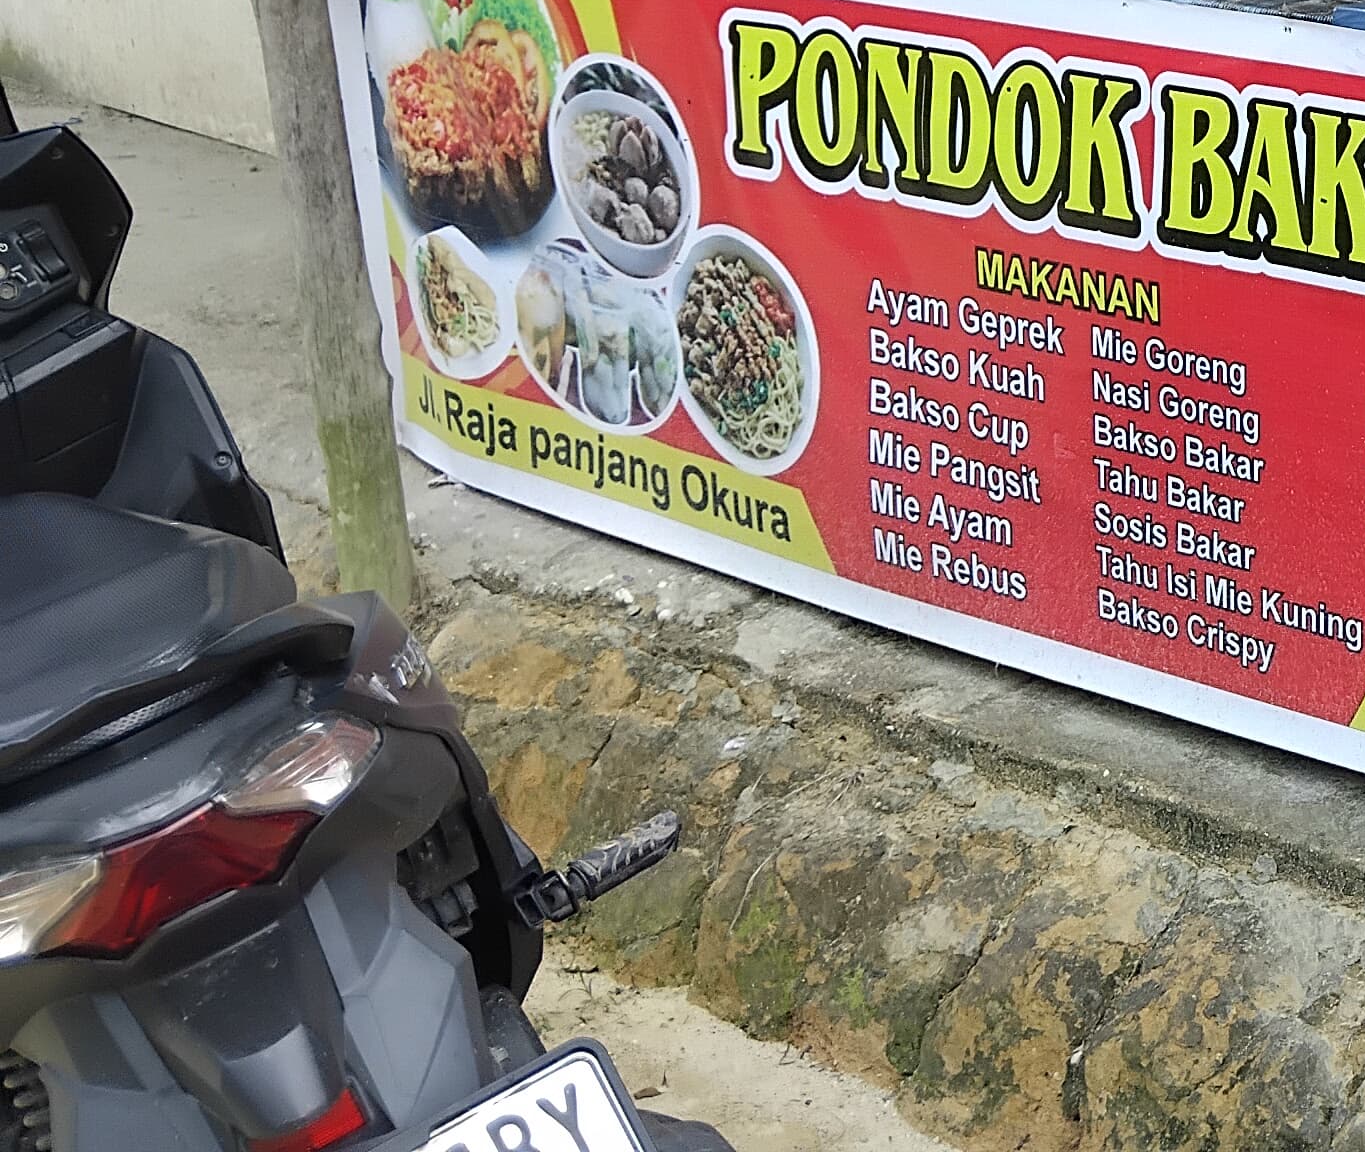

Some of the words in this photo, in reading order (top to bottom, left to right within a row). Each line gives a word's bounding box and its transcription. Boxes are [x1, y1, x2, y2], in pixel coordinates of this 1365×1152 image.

[731, 20, 1141, 238] PONDOK
[867, 278, 948, 329] Ayam
[958, 298, 1064, 355] Geprek
[976, 248, 1161, 324] MAKANAN
[869, 328, 960, 382] Bakso
[968, 350, 1046, 401] Kuah
[1091, 326, 1137, 364] Mie
[1144, 338, 1247, 396] Goreng
[869, 378, 959, 431] Bakso
[968, 404, 1029, 456] Cup
[1093, 371, 1150, 412] Nasi
[1158, 386, 1260, 444] Goreng
[444, 389, 518, 458] Raja
[529, 425, 670, 511] panjang
[681, 464, 791, 543] Okura
[868, 428, 921, 472] Mie
[930, 442, 1042, 505] Pangsit
[1094, 416, 1176, 462] Bakso
[1184, 437, 1264, 483] Bakar
[870, 479, 921, 521] Mie
[927, 495, 1012, 546] Ayam
[1094, 458, 1158, 501] Tahu
[1167, 476, 1244, 523] Bakar
[873, 528, 923, 571] Mie
[932, 544, 1028, 601] Rebus
[1094, 503, 1167, 547] Sosis
[1176, 523, 1256, 570] Bakar
[1095, 546, 1158, 589] Tahu
[1166, 565, 1198, 600] Isi
[1205, 574, 1253, 615] Mie
[1261, 589, 1363, 649] Kuning
[1098, 589, 1180, 638] Bakso
[1187, 614, 1275, 673] Crispy
